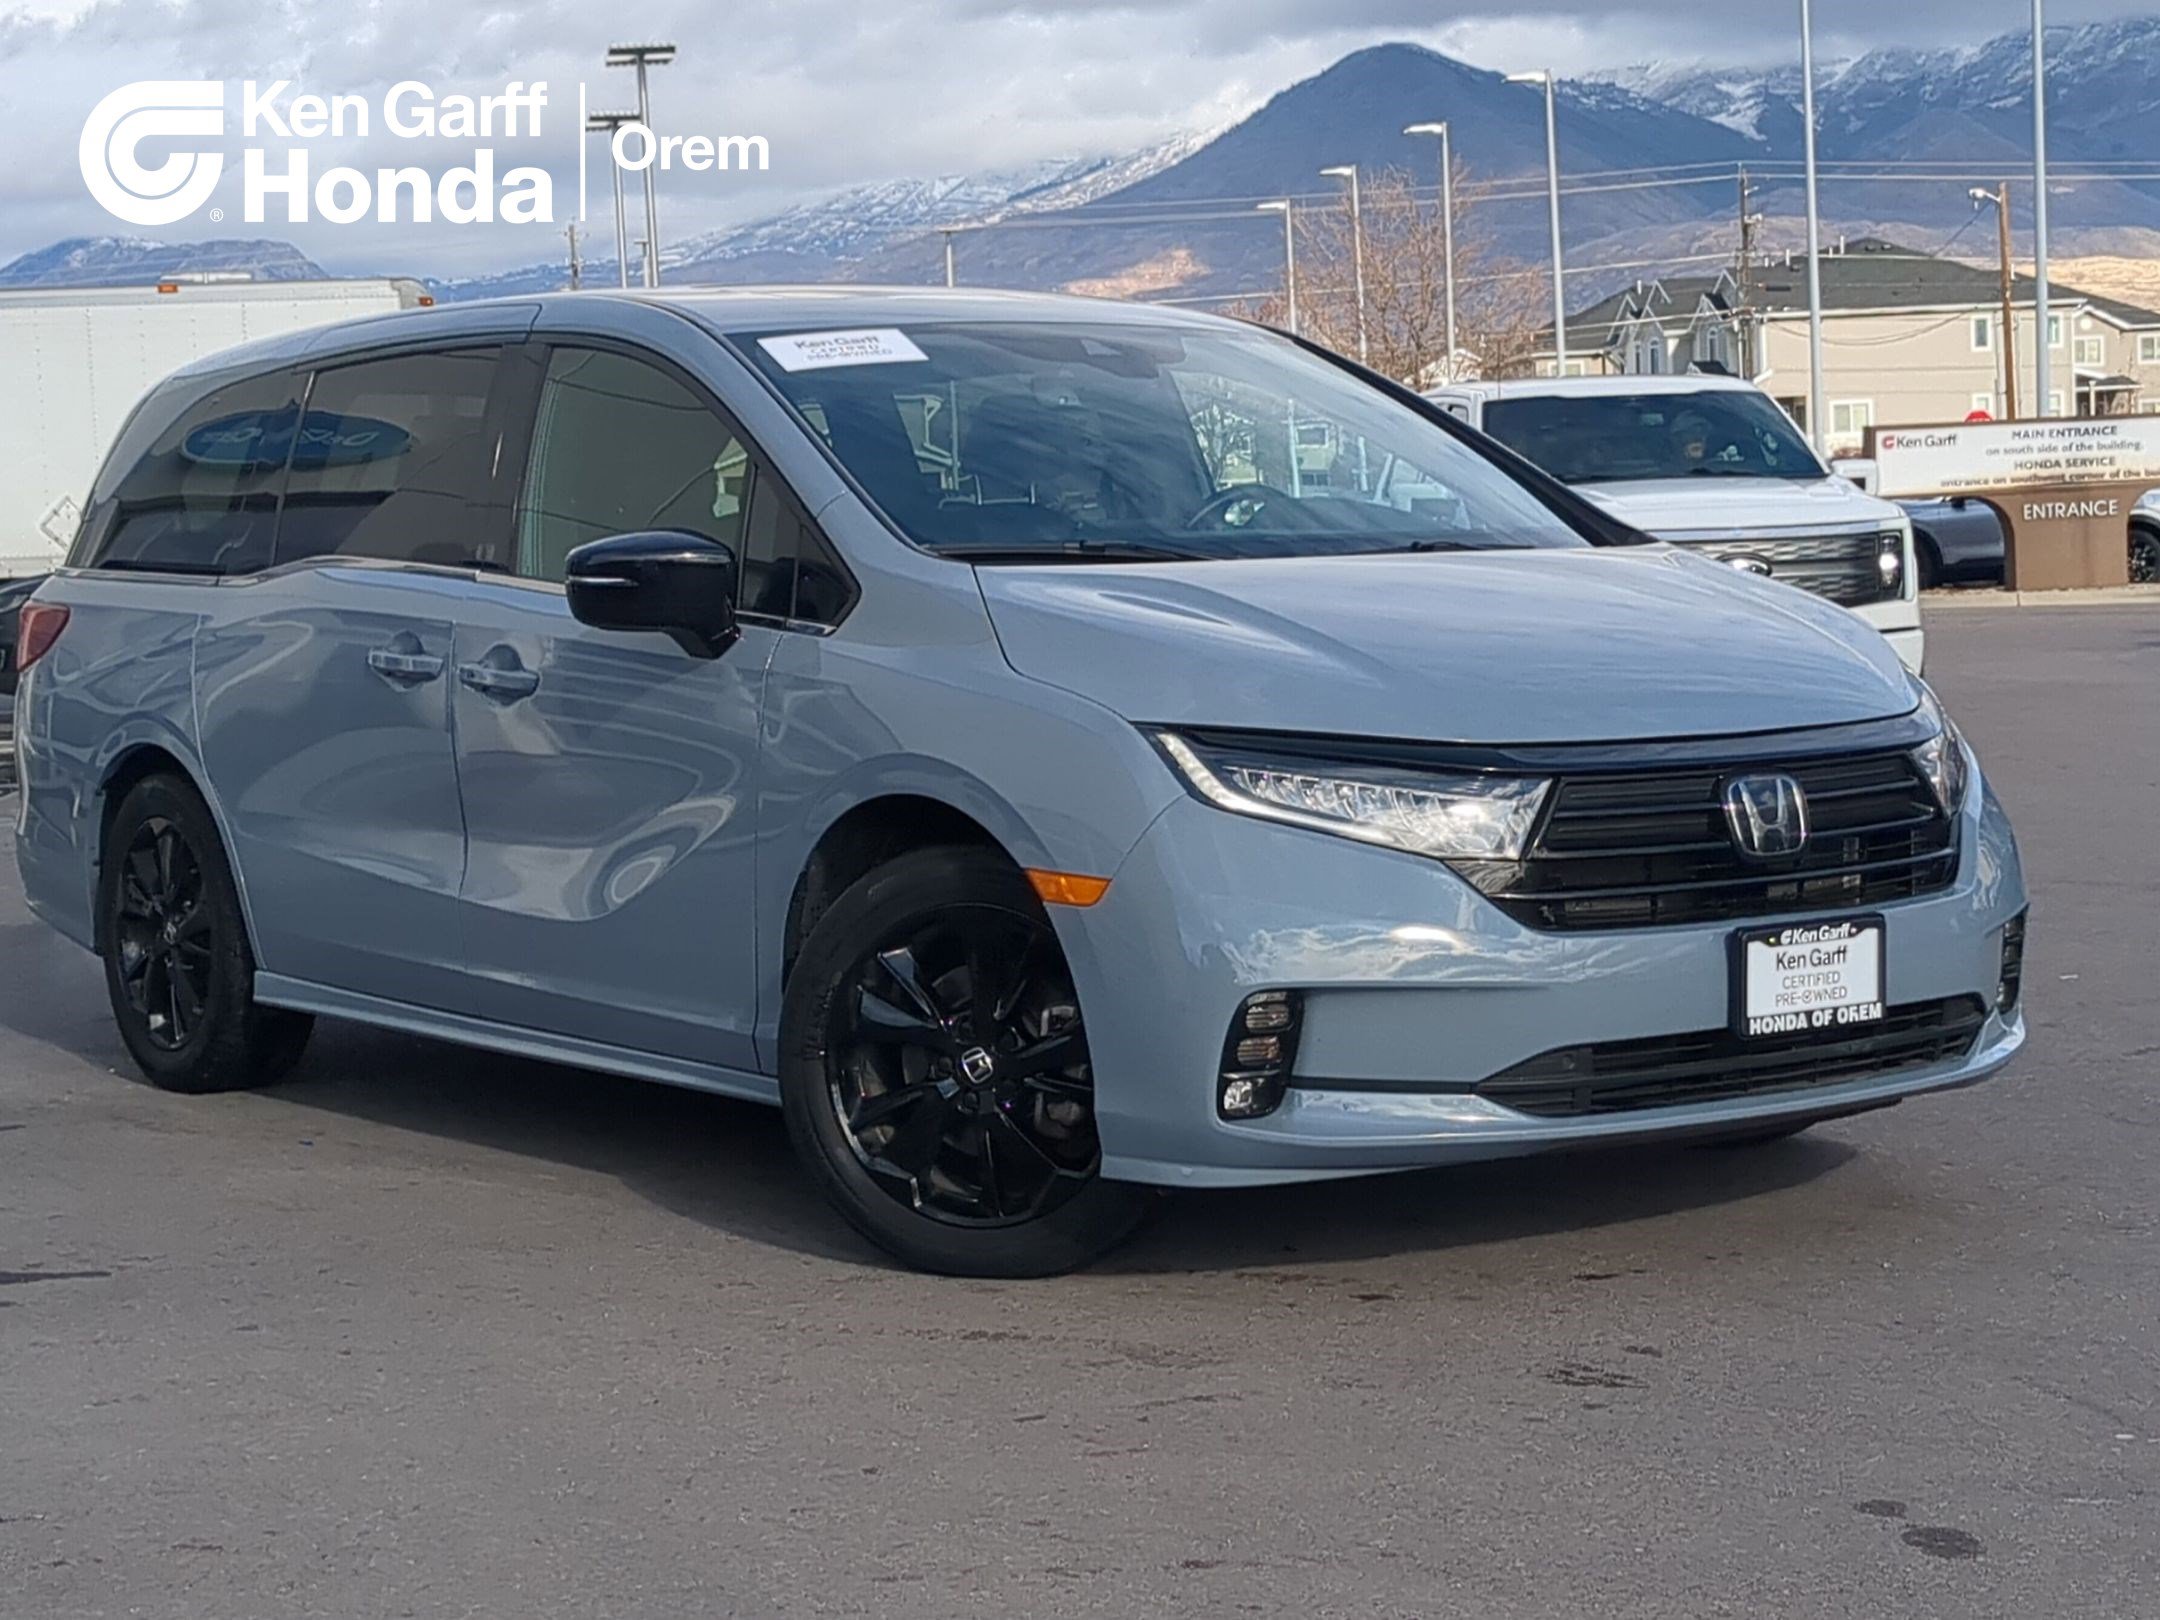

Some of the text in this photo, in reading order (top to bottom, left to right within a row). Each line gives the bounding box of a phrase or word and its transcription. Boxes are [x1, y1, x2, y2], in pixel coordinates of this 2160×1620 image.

[1896, 434, 1957, 449] Ken Garff
[2012, 425, 2118, 440] MAIN ENTRANCE
[1986, 448, 2000, 456] on
[2003, 444, 2034, 455] south
[2037, 443, 2059, 453] side
[2061, 442, 2074, 452] of
[2075, 440, 2094, 451] the
[2014, 456, 2116, 471] HONDA SERVICE
[1940, 478, 1990, 488] entrance
[1993, 477, 2007, 485] on
[2069, 473, 2107, 482] corner
[2109, 469, 2122, 479] of
[2123, 468, 2142, 479] the
[2023, 500, 2119, 520] ENTRANCE
[1791, 922, 1851, 944] Ken Garff
[1776, 945, 1847, 972] Ken Garff
[1782, 971, 1841, 989] CERTIFIED
[1749, 1002, 1883, 1036] HONDA OF OREM
